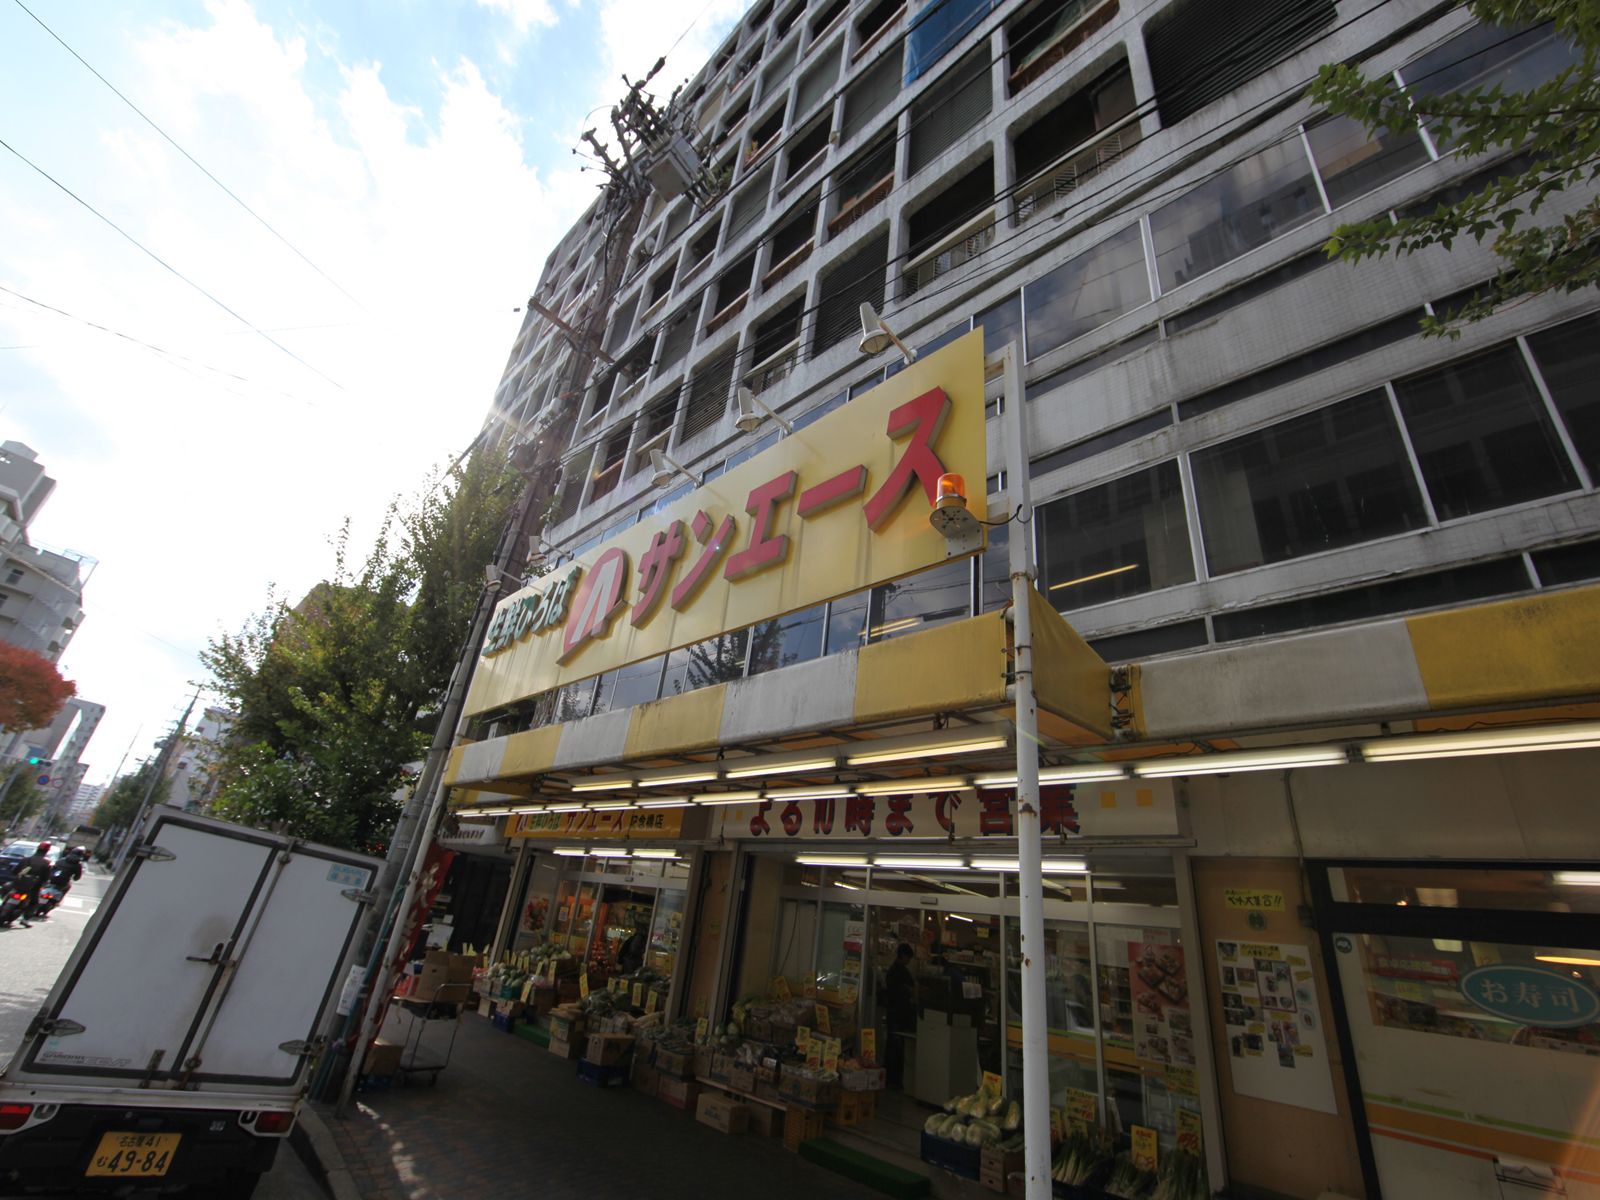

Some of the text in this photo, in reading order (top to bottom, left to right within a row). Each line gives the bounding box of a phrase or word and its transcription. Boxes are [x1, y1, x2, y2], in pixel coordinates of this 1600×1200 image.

[630, 386, 951, 627] サンエース
[481, 565, 582, 657] 生鮮ひろば
[1479, 977, 1581, 1014] お寿司
[107, 1150, 170, 1172] 49-84
